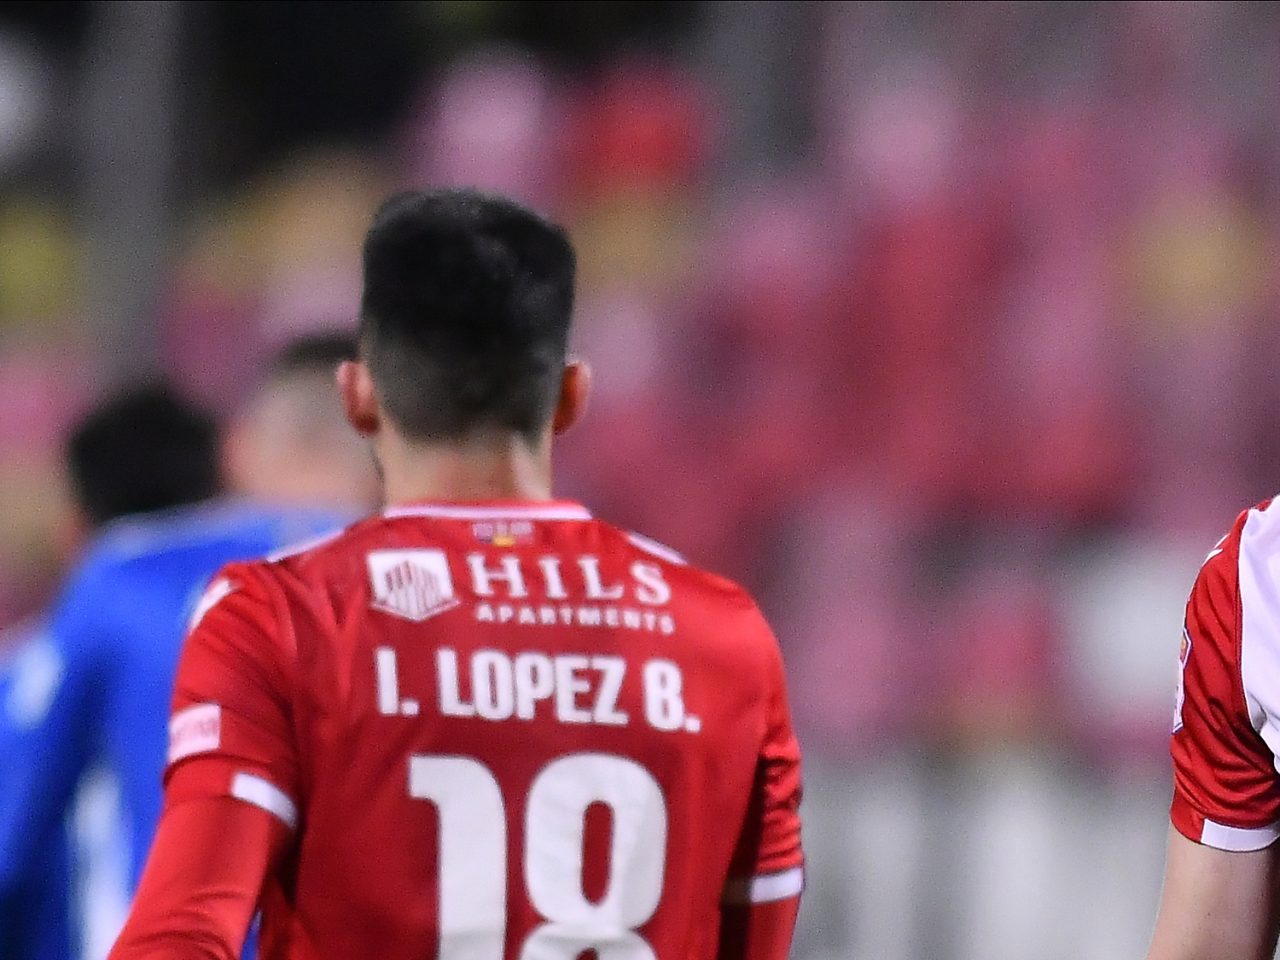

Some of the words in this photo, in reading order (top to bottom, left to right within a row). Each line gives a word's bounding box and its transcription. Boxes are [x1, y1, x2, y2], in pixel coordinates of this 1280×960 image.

[466, 553, 672, 605] HILS
[476, 602, 676, 635] APARTMENTS
[375, 647, 419, 716] I.
[436, 649, 628, 725] LOPEZ
[643, 658, 703, 733] B.
